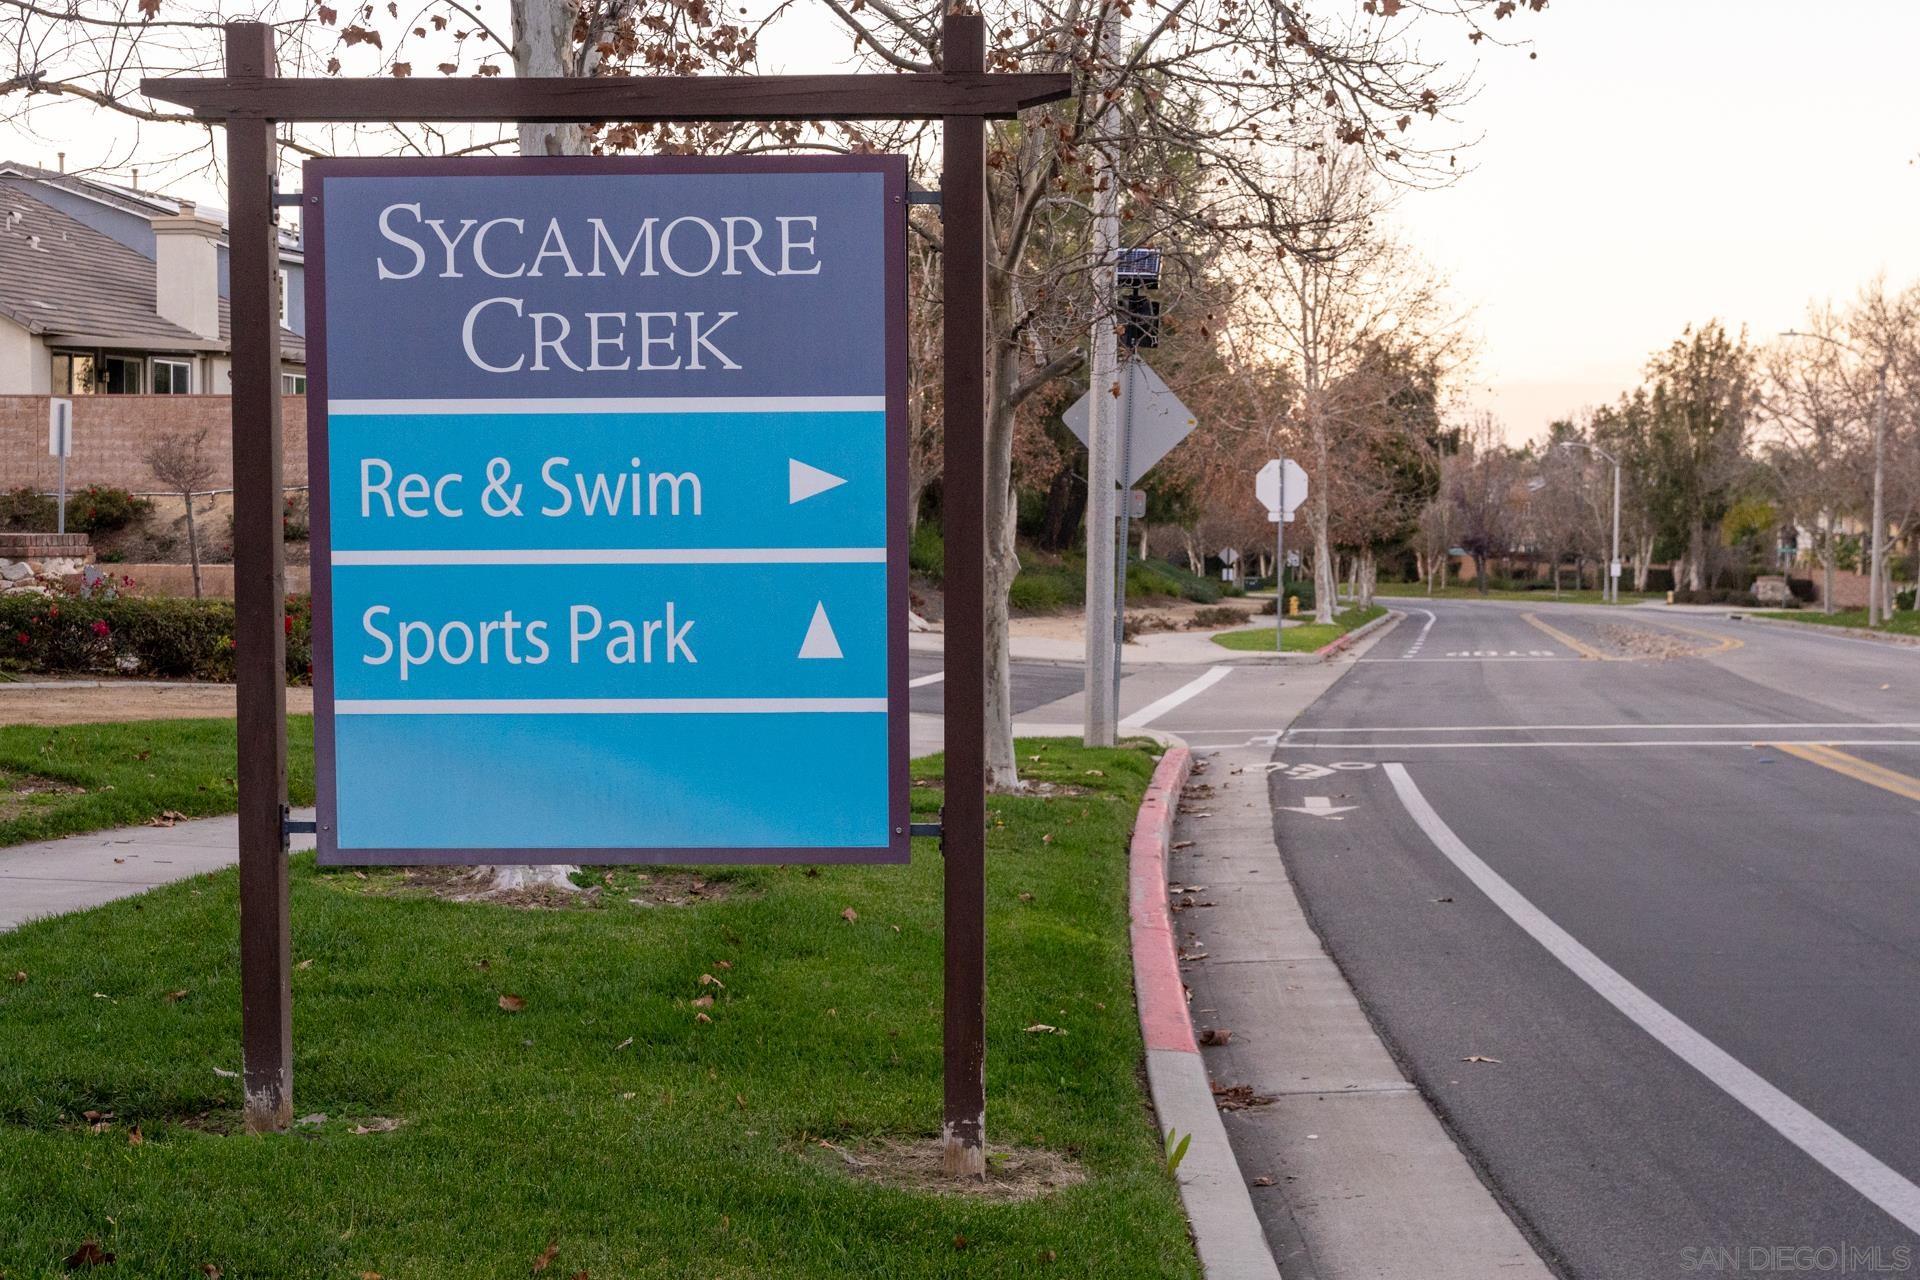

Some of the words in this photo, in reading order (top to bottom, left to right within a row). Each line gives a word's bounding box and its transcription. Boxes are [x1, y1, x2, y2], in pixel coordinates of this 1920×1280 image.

[376, 202, 822, 280] SYCAMORE
[462, 296, 743, 373] CREEK
[361, 458, 463, 517] Rec
[481, 457, 522, 517] &
[541, 456, 702, 517] Swim
[362, 605, 549, 680] Sports
[570, 602, 698, 664] Park
